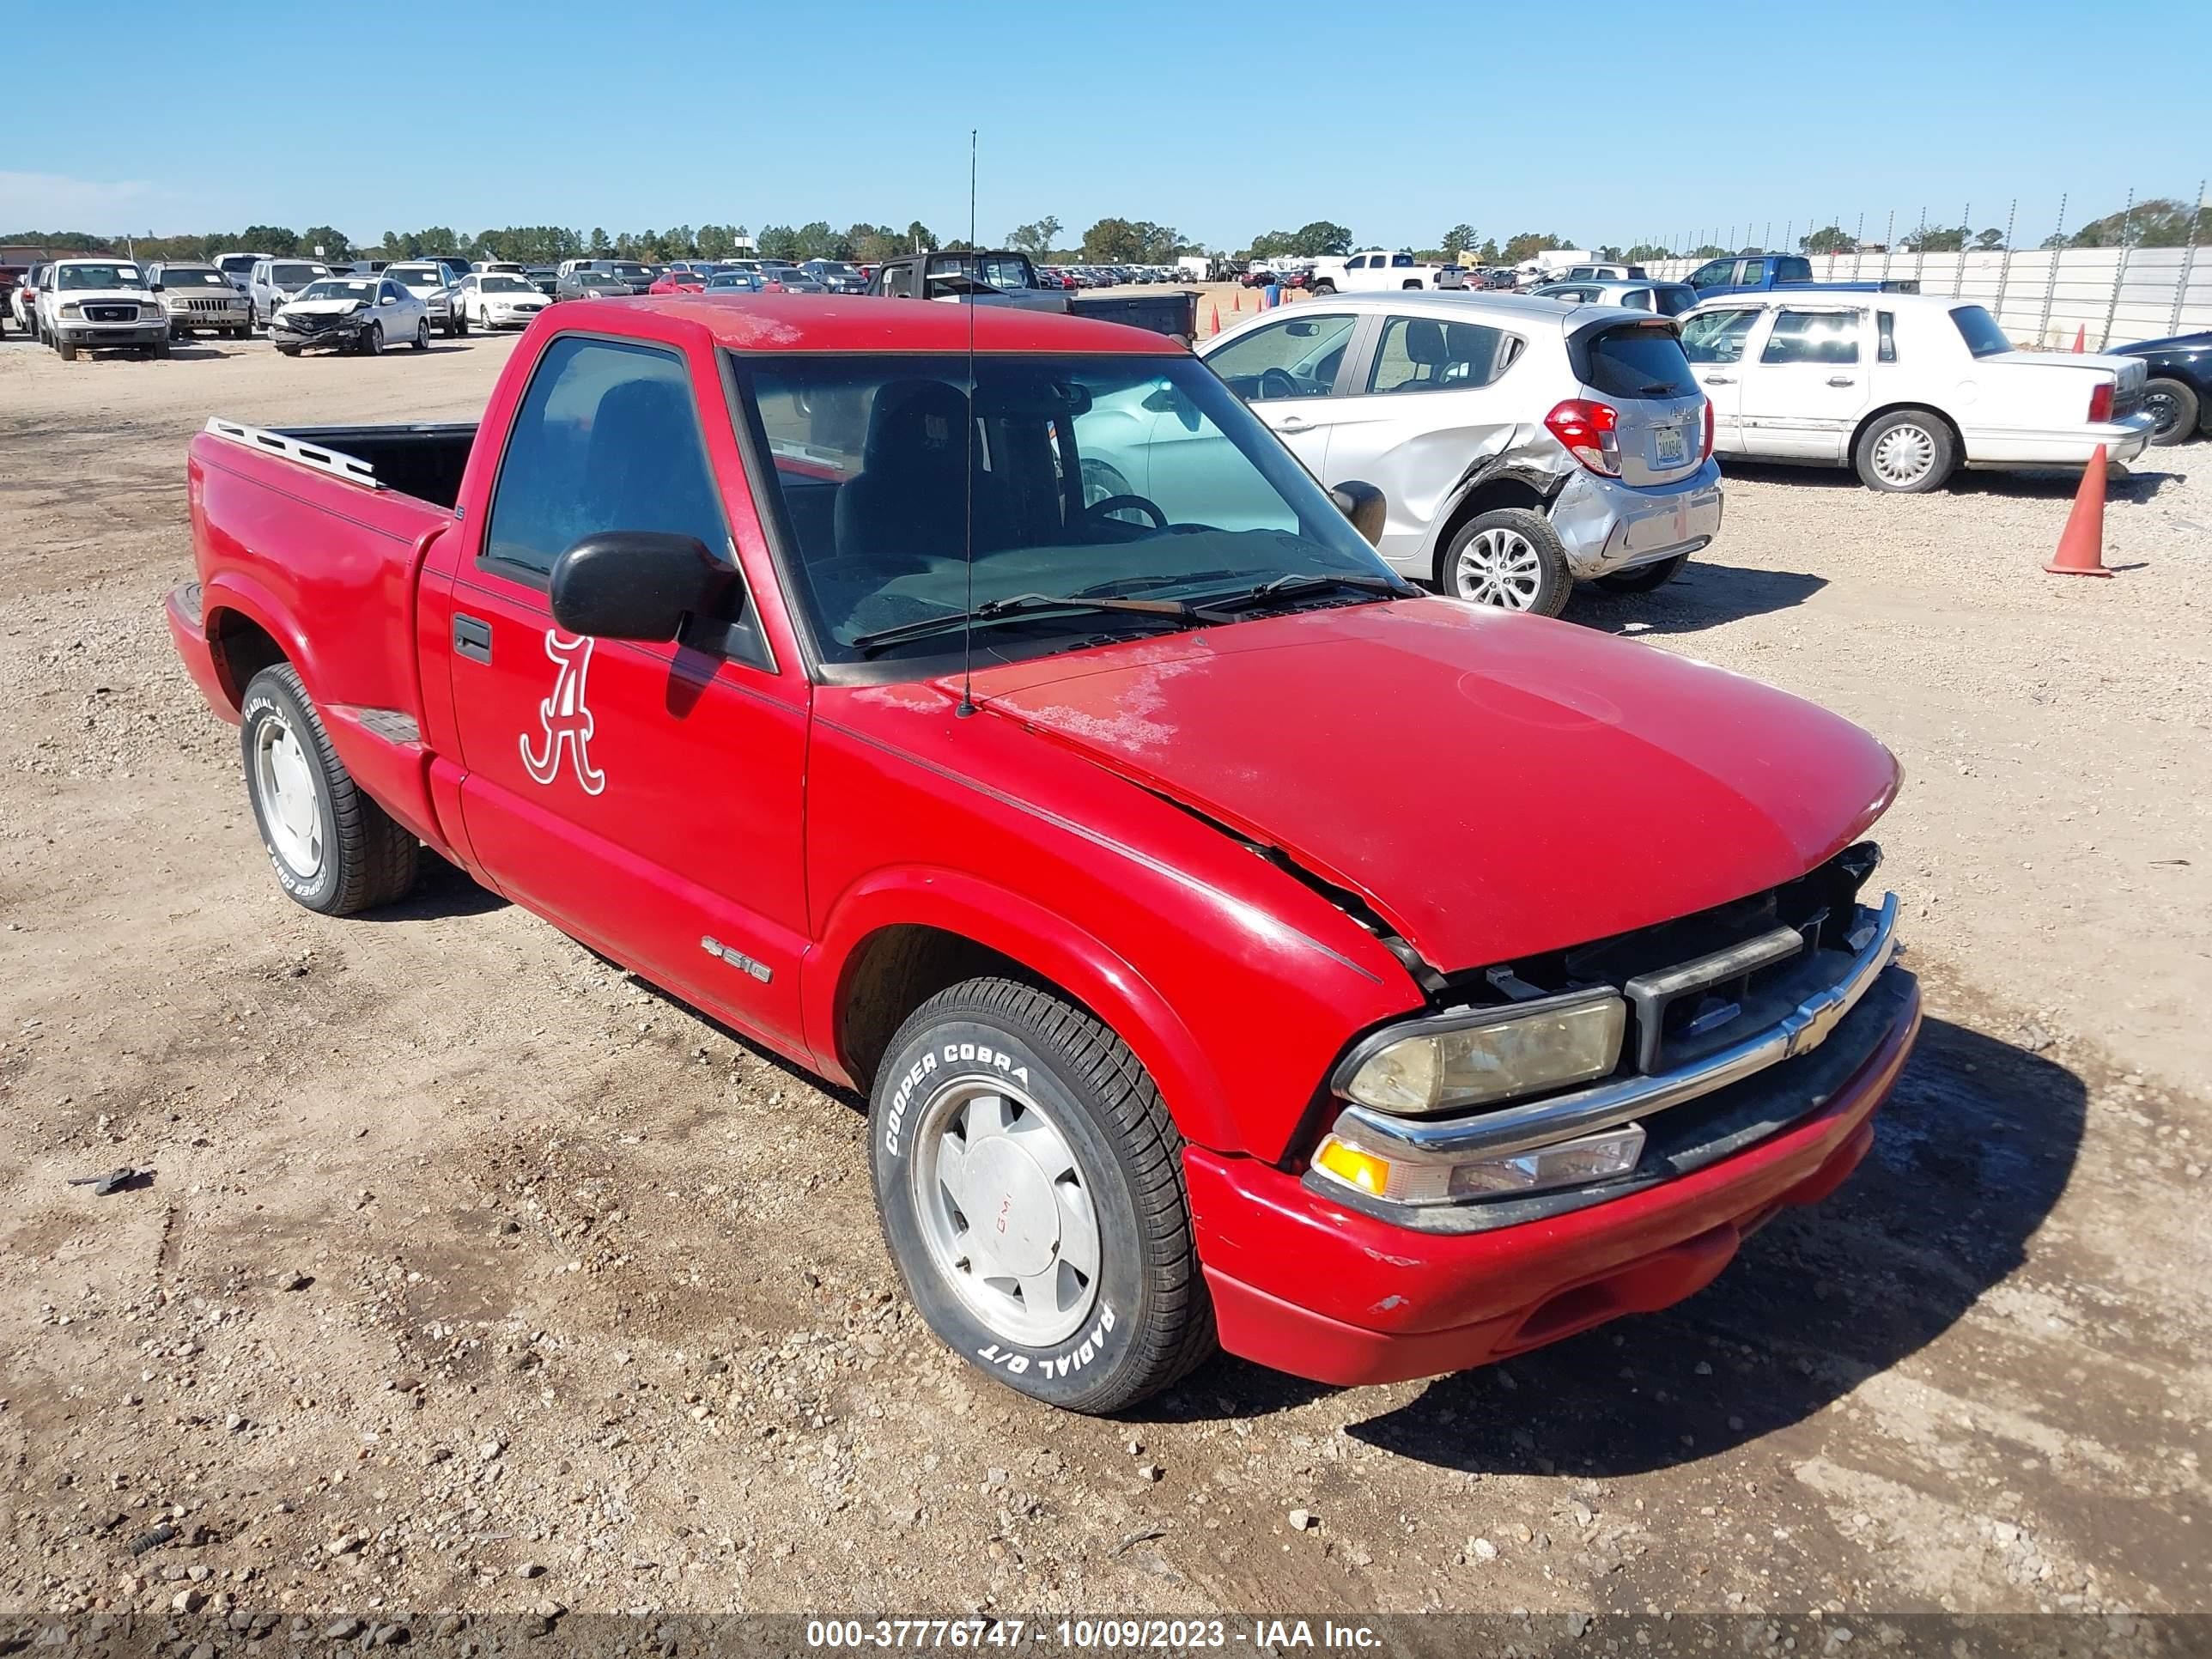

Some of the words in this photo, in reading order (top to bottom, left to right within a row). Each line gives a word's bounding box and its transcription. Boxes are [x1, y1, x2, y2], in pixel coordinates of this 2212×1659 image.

[245, 696, 275, 723] RADIAL
[519, 629, 605, 796] A
[294, 862, 328, 896] COOPER
[885, 1055, 939, 1157] COOPER
[944, 1043, 1030, 1088] COBRA
[977, 1344, 1030, 1374] G/T
[1038, 1304, 1115, 1379] RADIAL
